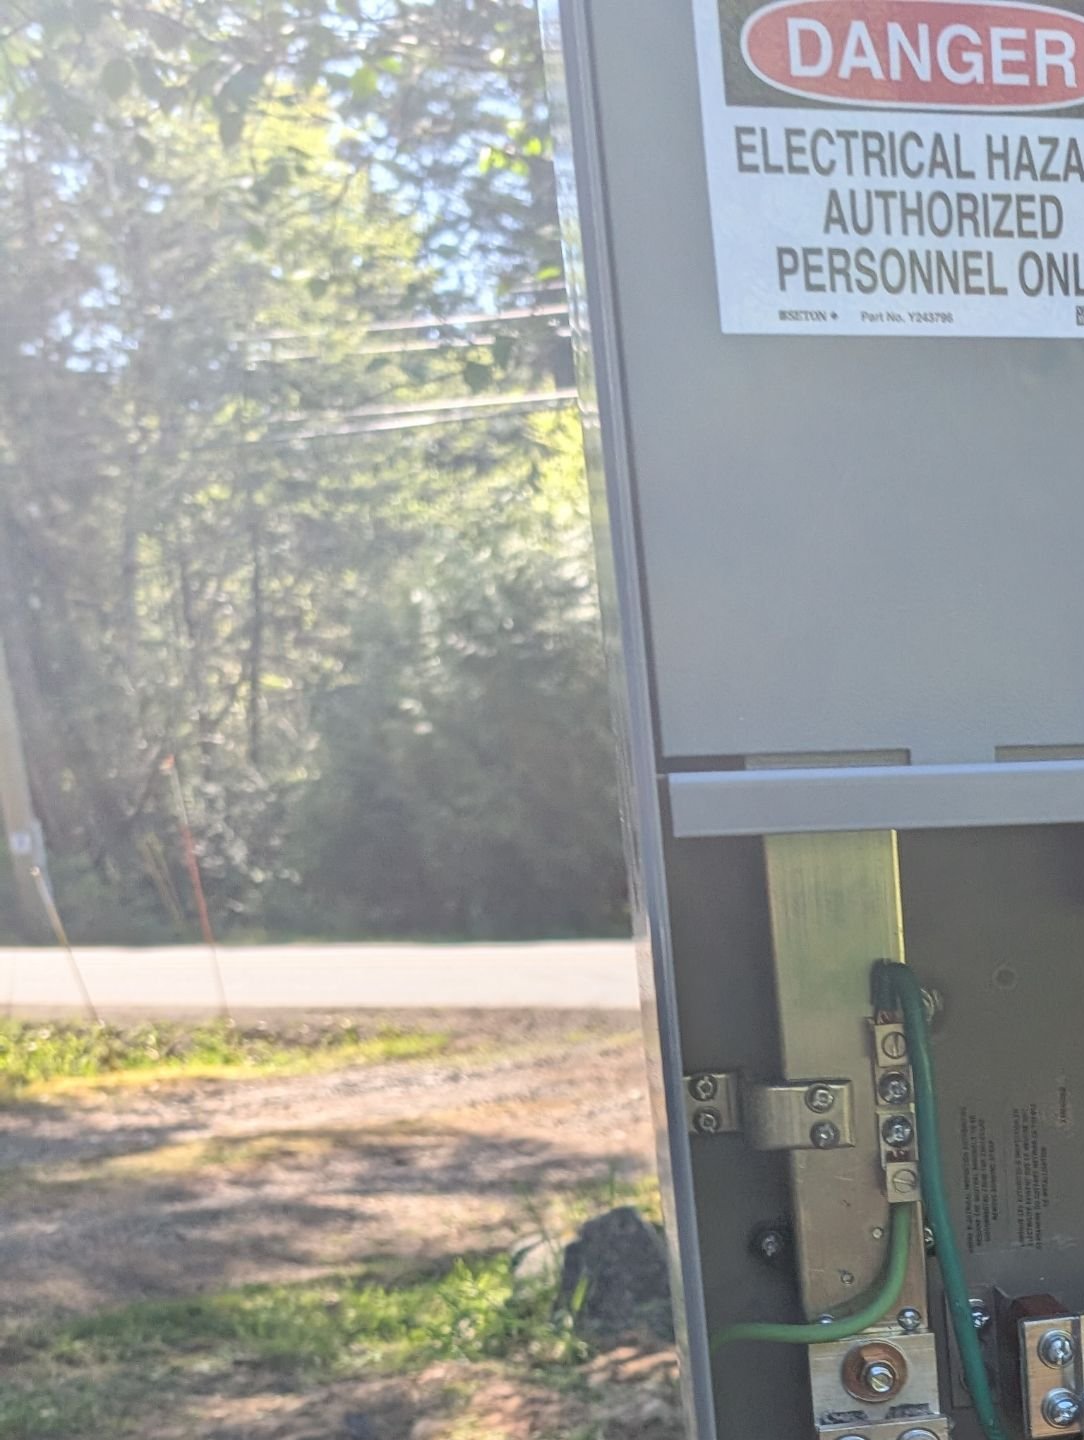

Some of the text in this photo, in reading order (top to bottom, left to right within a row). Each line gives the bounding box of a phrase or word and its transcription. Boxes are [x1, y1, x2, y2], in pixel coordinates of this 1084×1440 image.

[785, 16, 1078, 89] DANGER
[734, 125, 976, 180] ELECTRICAL
[823, 188, 1064, 239] AUTHORIZED
[776, 246, 1008, 296] PERSONNEL
[860, 310, 884, 323] Part
[886, 311, 905, 324] No.
